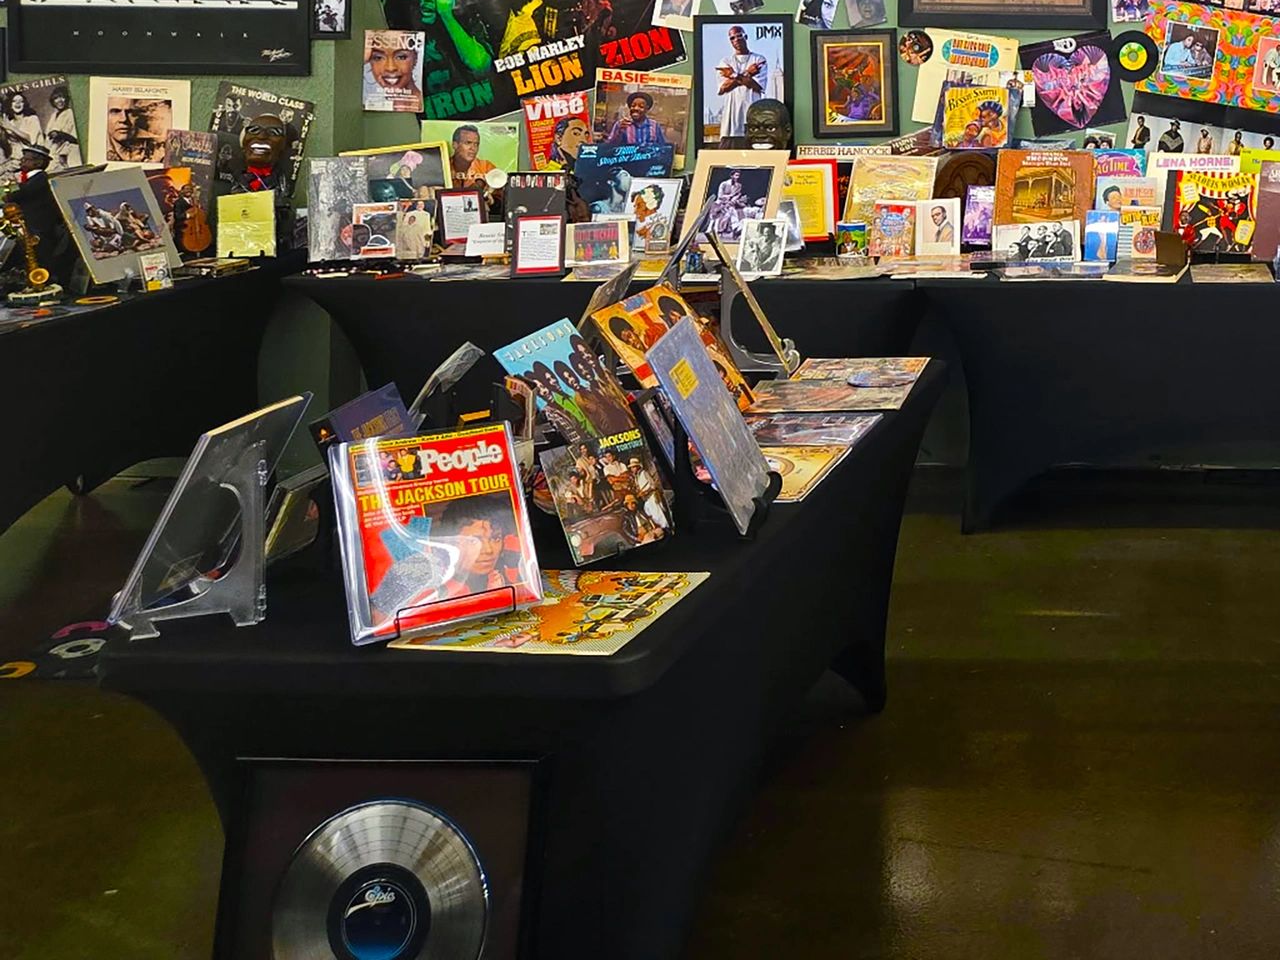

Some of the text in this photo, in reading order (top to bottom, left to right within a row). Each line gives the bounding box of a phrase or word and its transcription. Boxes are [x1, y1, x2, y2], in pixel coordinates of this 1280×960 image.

[756, 26, 783, 39] DMX
[495, 36, 585, 72] BOB MARLEY
[601, 27, 674, 68] ZION
[32, 76, 65, 88] GIRLS
[512, 53, 584, 95] LION
[602, 70, 649, 84] BASIE
[231, 85, 305, 110] THE WORLD CLASS
[426, 80, 494, 120] IRON
[799, 146, 834, 156] HERBIE
[1156, 157, 1185, 169] LENA
[418, 440, 503, 475] People
[395, 474, 510, 506] JACKSON TOUR
[365, 886, 396, 907] Epic
